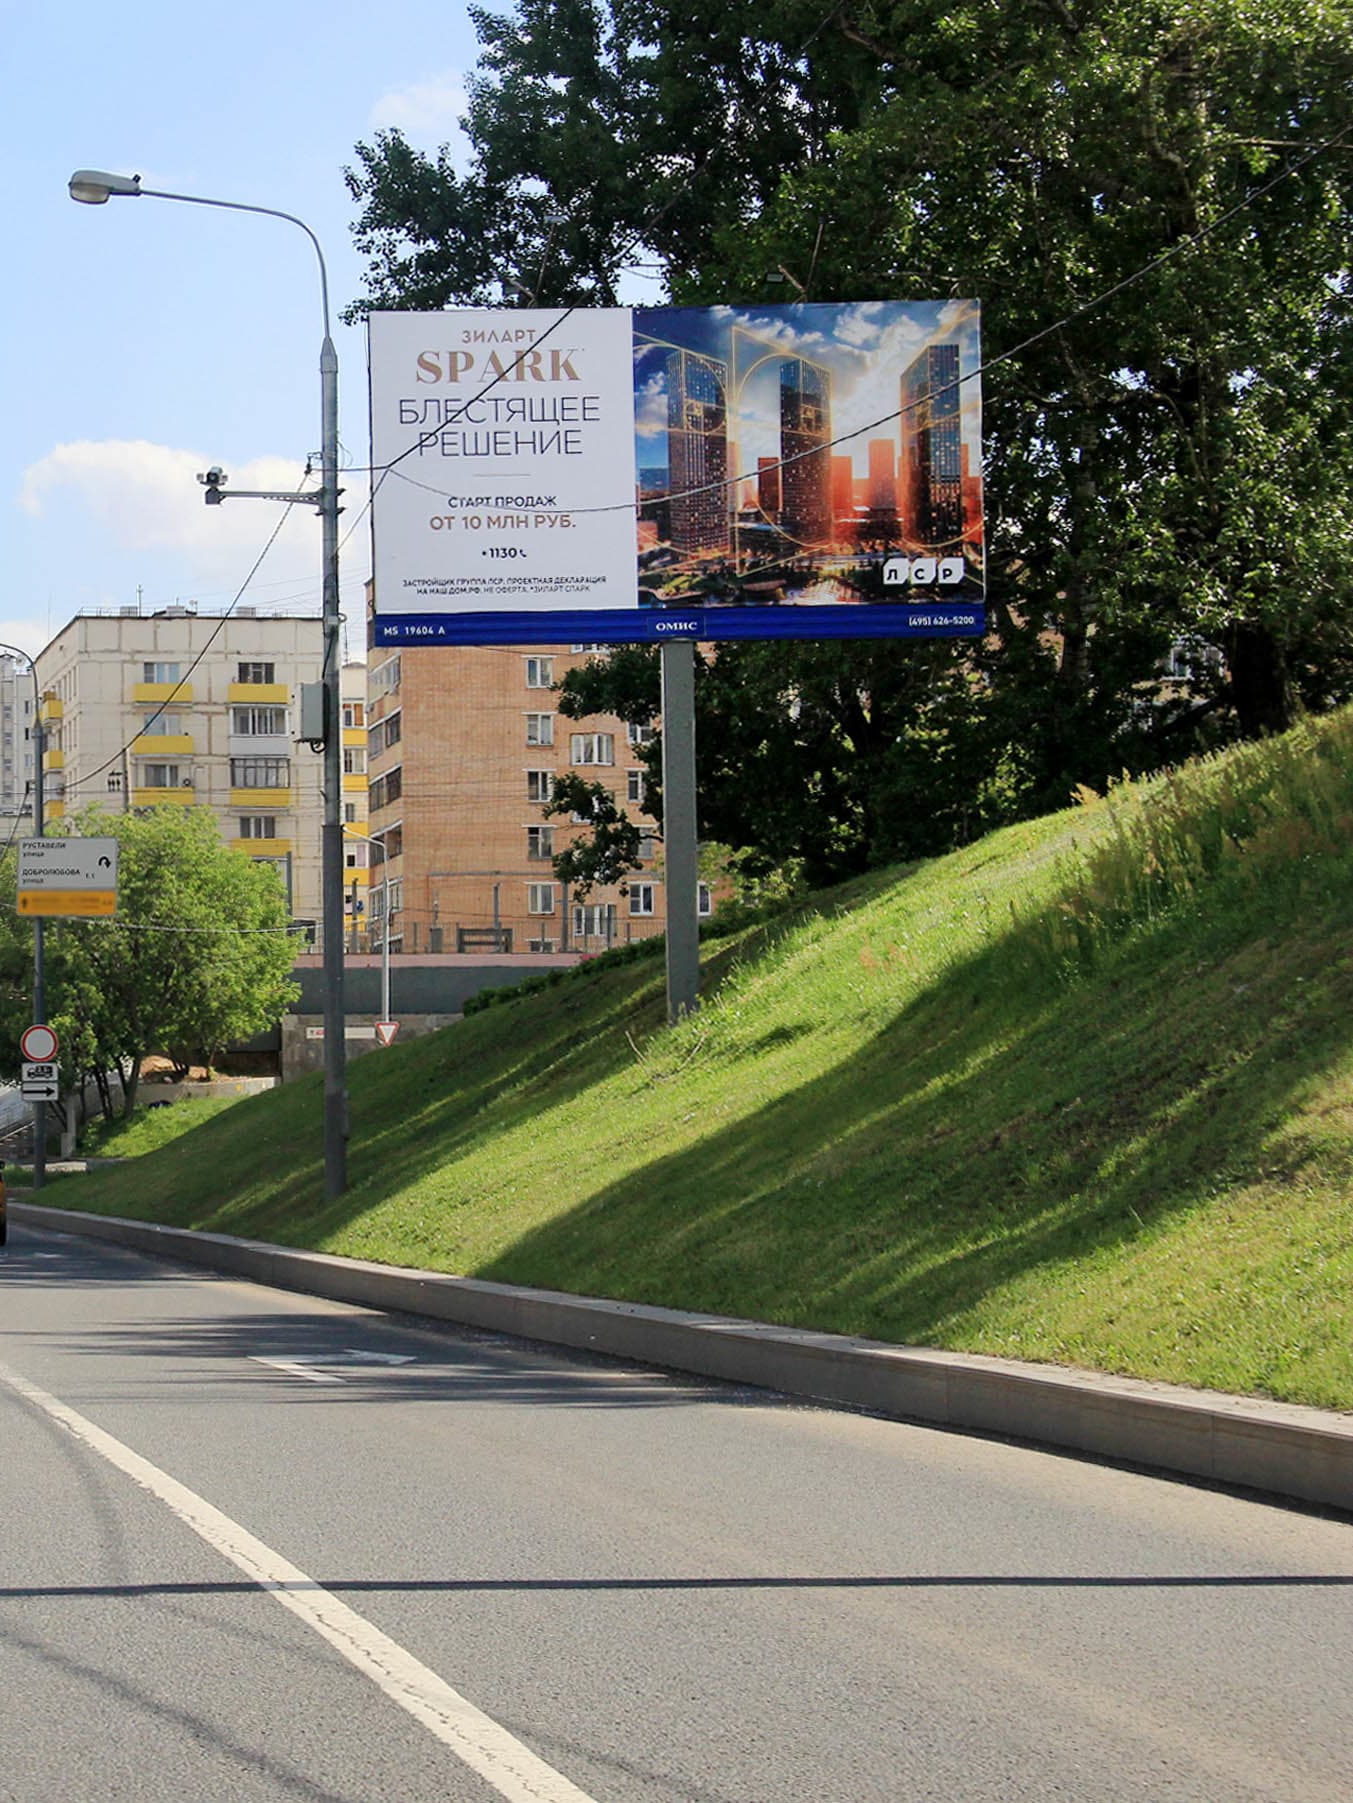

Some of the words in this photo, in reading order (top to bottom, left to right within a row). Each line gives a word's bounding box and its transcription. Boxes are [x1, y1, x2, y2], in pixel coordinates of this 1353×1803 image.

[462, 329, 537, 344] ЗИЛАРТ
[416, 348, 581, 384] SPARK
[399, 396, 600, 425] БЛЕСТЯЩЕЕ
[419, 430, 583, 457] РЕШЕНИЕ
[448, 496, 491, 508] СТАРТ
[495, 495, 557, 508] ПРОДАЖ
[430, 516, 455, 530] ОТ
[462, 516, 481, 530] 10
[487, 515, 529, 529] МЛН
[534, 514, 576, 528] РУБ.
[656, 621, 697, 631] ОМИС
[933, 616, 975, 626] 626-5200
